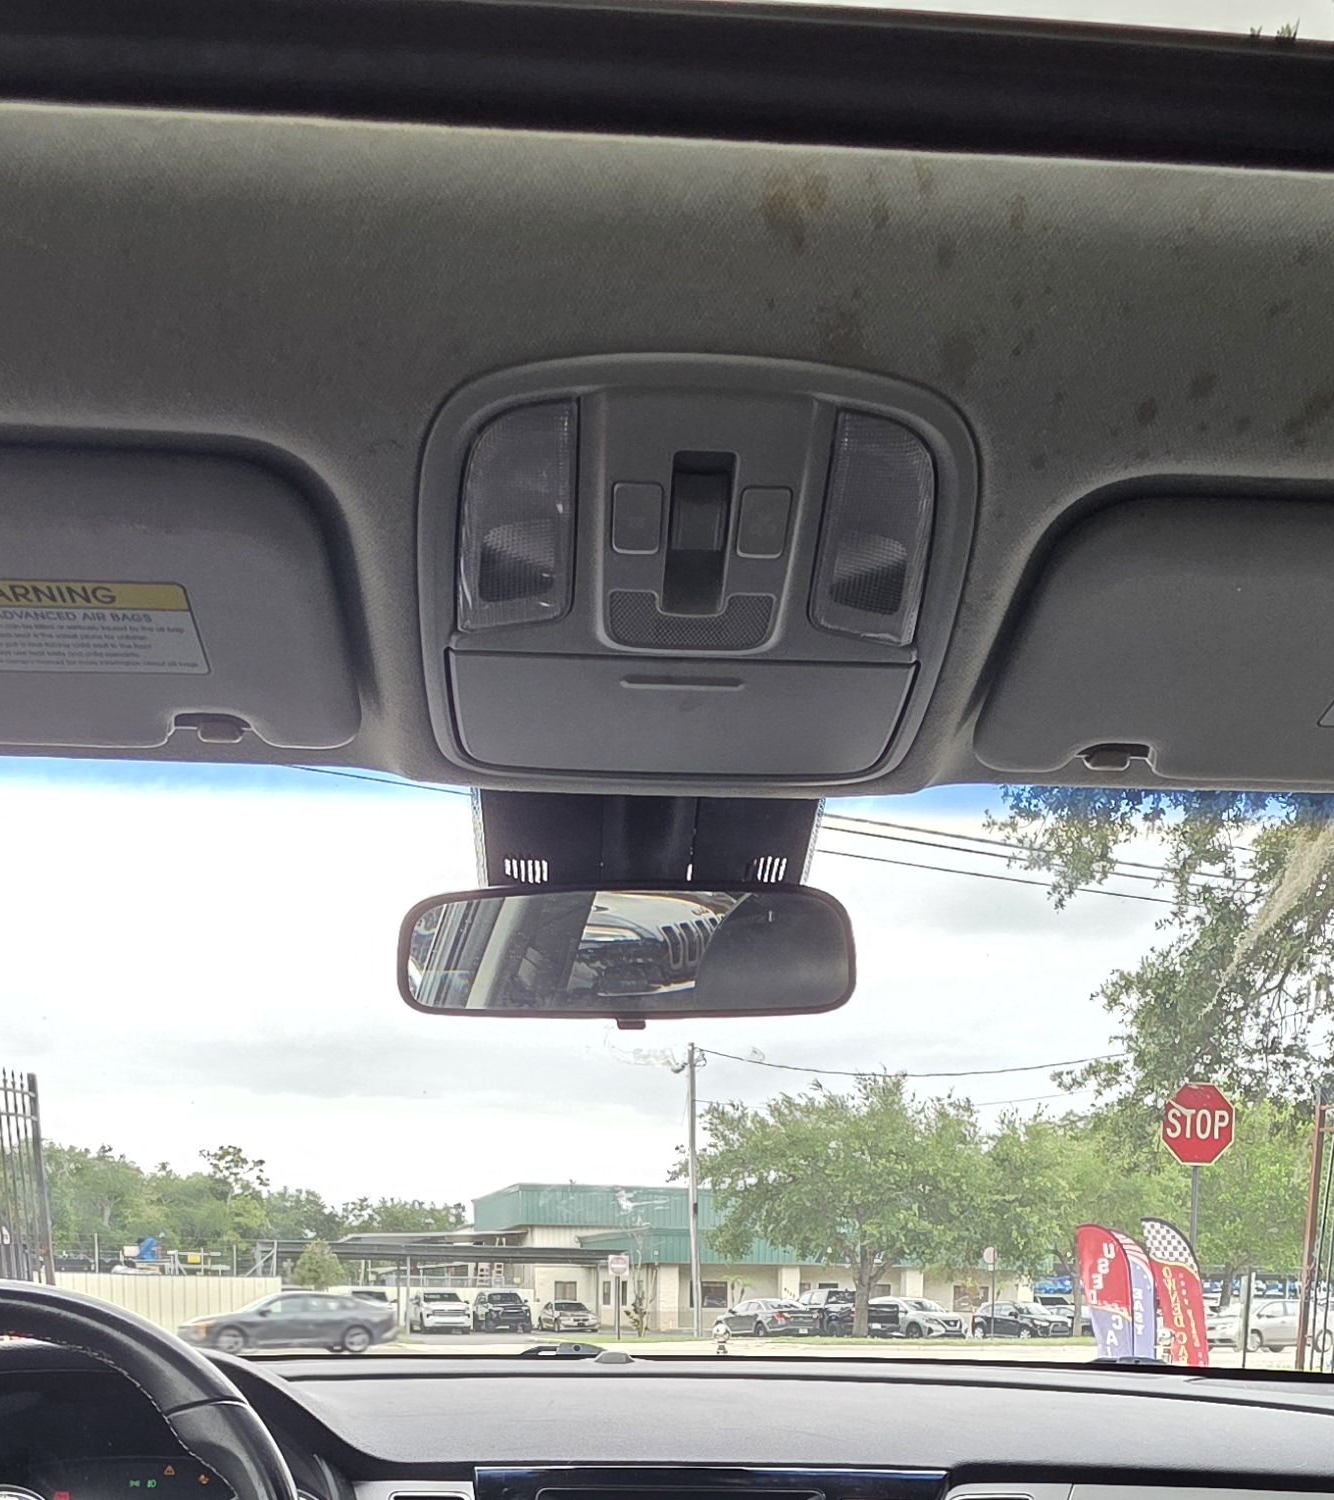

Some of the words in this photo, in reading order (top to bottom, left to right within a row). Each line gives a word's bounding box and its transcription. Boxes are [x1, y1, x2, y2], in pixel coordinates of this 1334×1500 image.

[81, 612, 107, 622] AIR
[108, 612, 153, 623] BAGS
[1166, 1108, 1230, 1140] STOP
